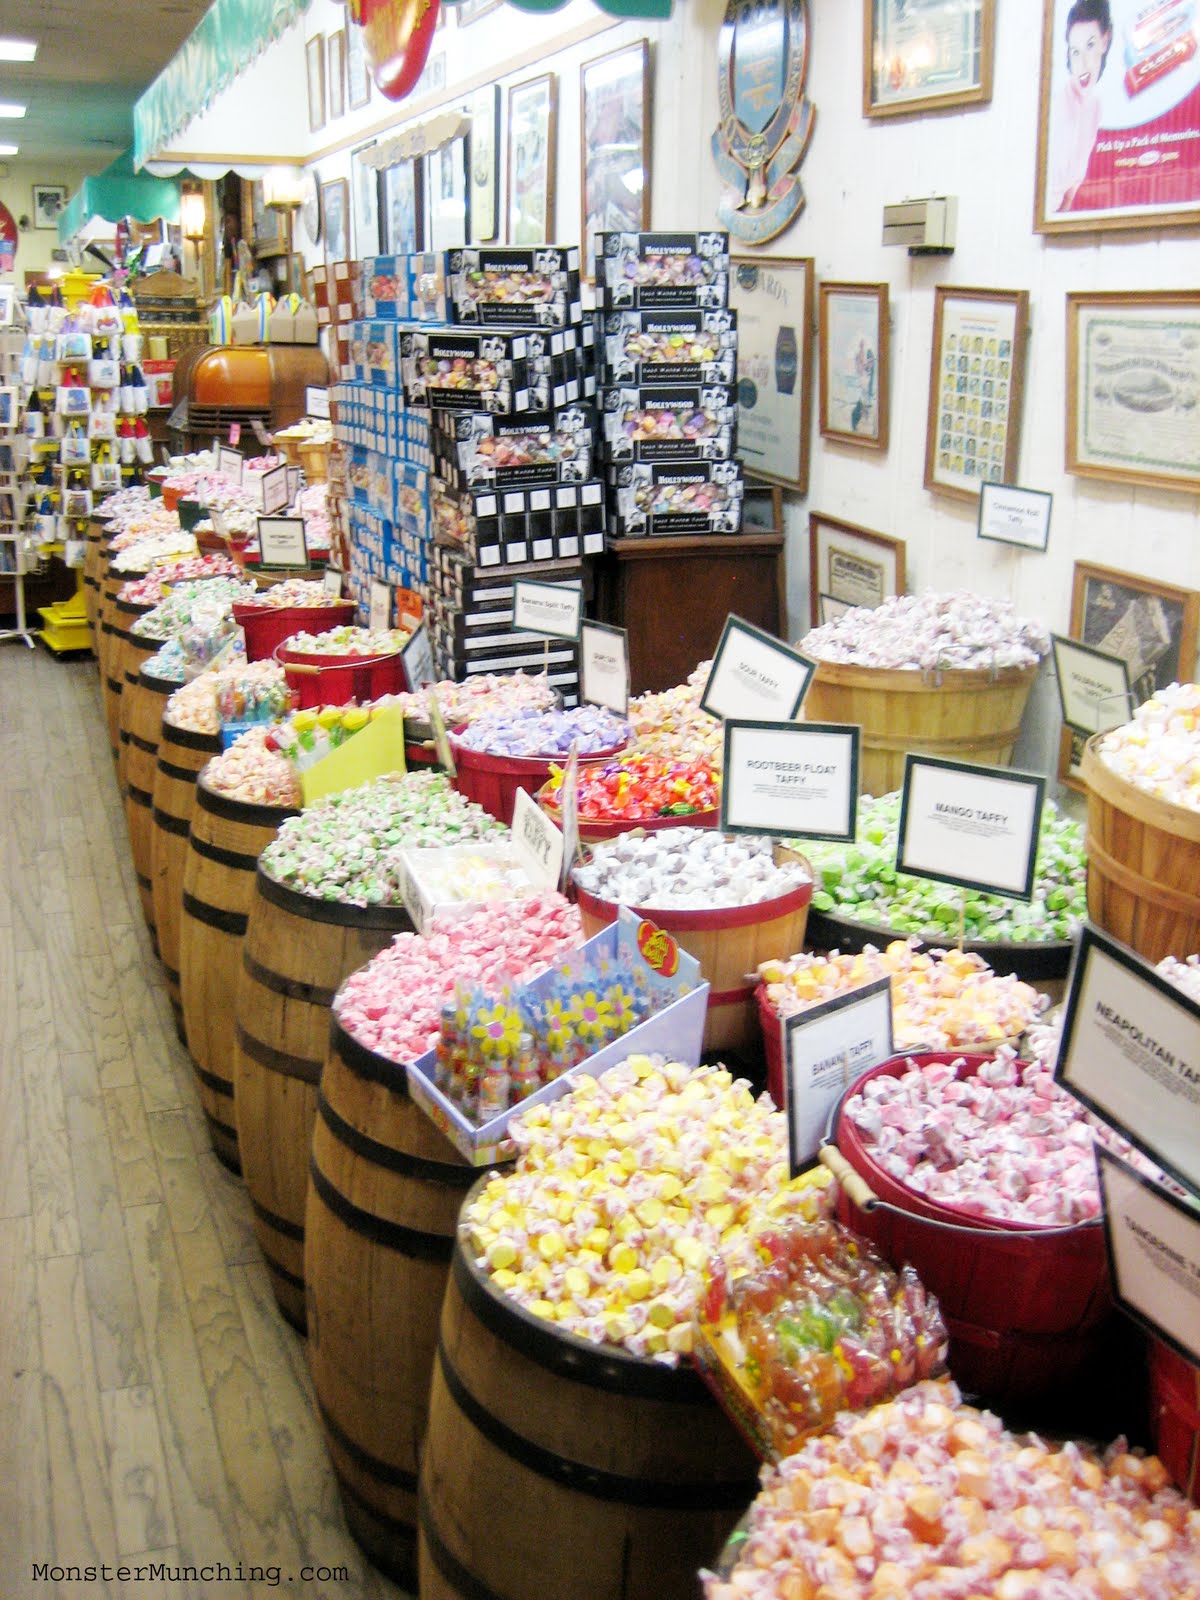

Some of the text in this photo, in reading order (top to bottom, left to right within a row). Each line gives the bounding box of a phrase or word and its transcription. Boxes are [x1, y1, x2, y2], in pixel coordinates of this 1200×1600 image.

[759, 673, 779, 688] TAFFY
[746, 760, 837, 774] ROOTBEER FLOAT
[775, 774, 807, 784] TAFFY
[935, 802, 1009, 825] MANGO TAFFY
[1095, 1000, 1176, 1067] NEAPOLITAN
